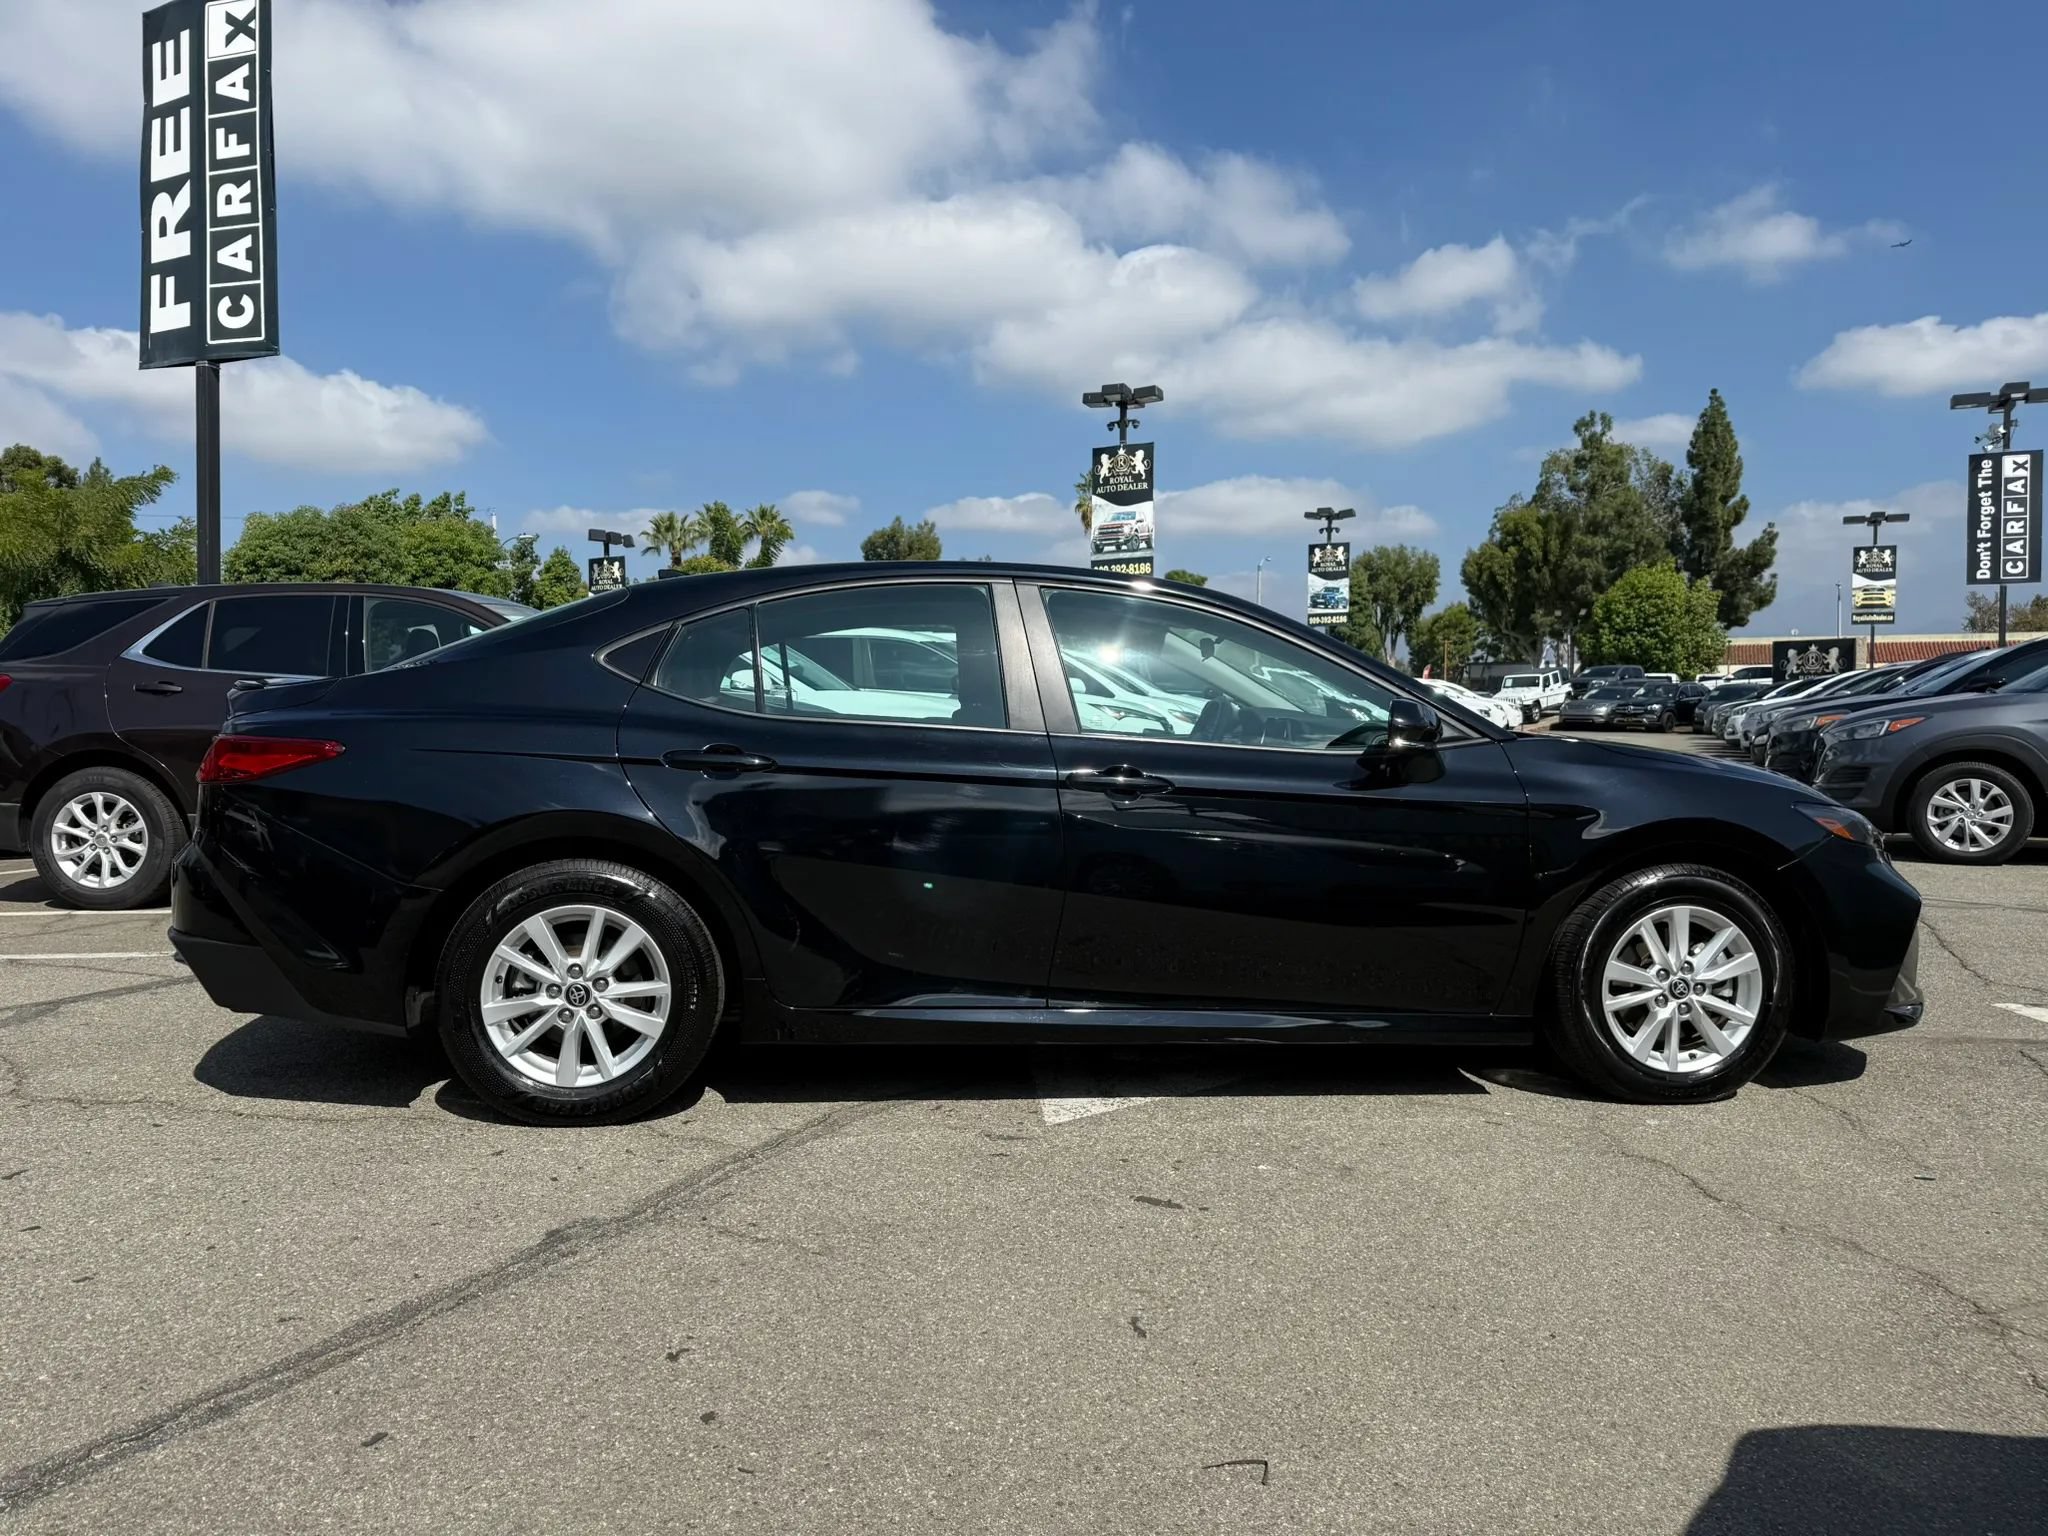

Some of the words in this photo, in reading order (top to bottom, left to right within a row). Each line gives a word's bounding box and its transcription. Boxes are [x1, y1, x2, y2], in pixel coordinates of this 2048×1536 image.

[151, 29, 191, 334] FREE
[215, 3, 256, 330] CARFAX
[1096, 485, 1117, 494] AUTO
[1117, 482, 1149, 492] DEALER
[1109, 475, 1134, 484] ROYAL
[1977, 459, 1993, 488] The
[1977, 493, 1996, 541] Forget
[2005, 459, 2029, 575] CARFAX
[1976, 541, 1991, 580] Don't
